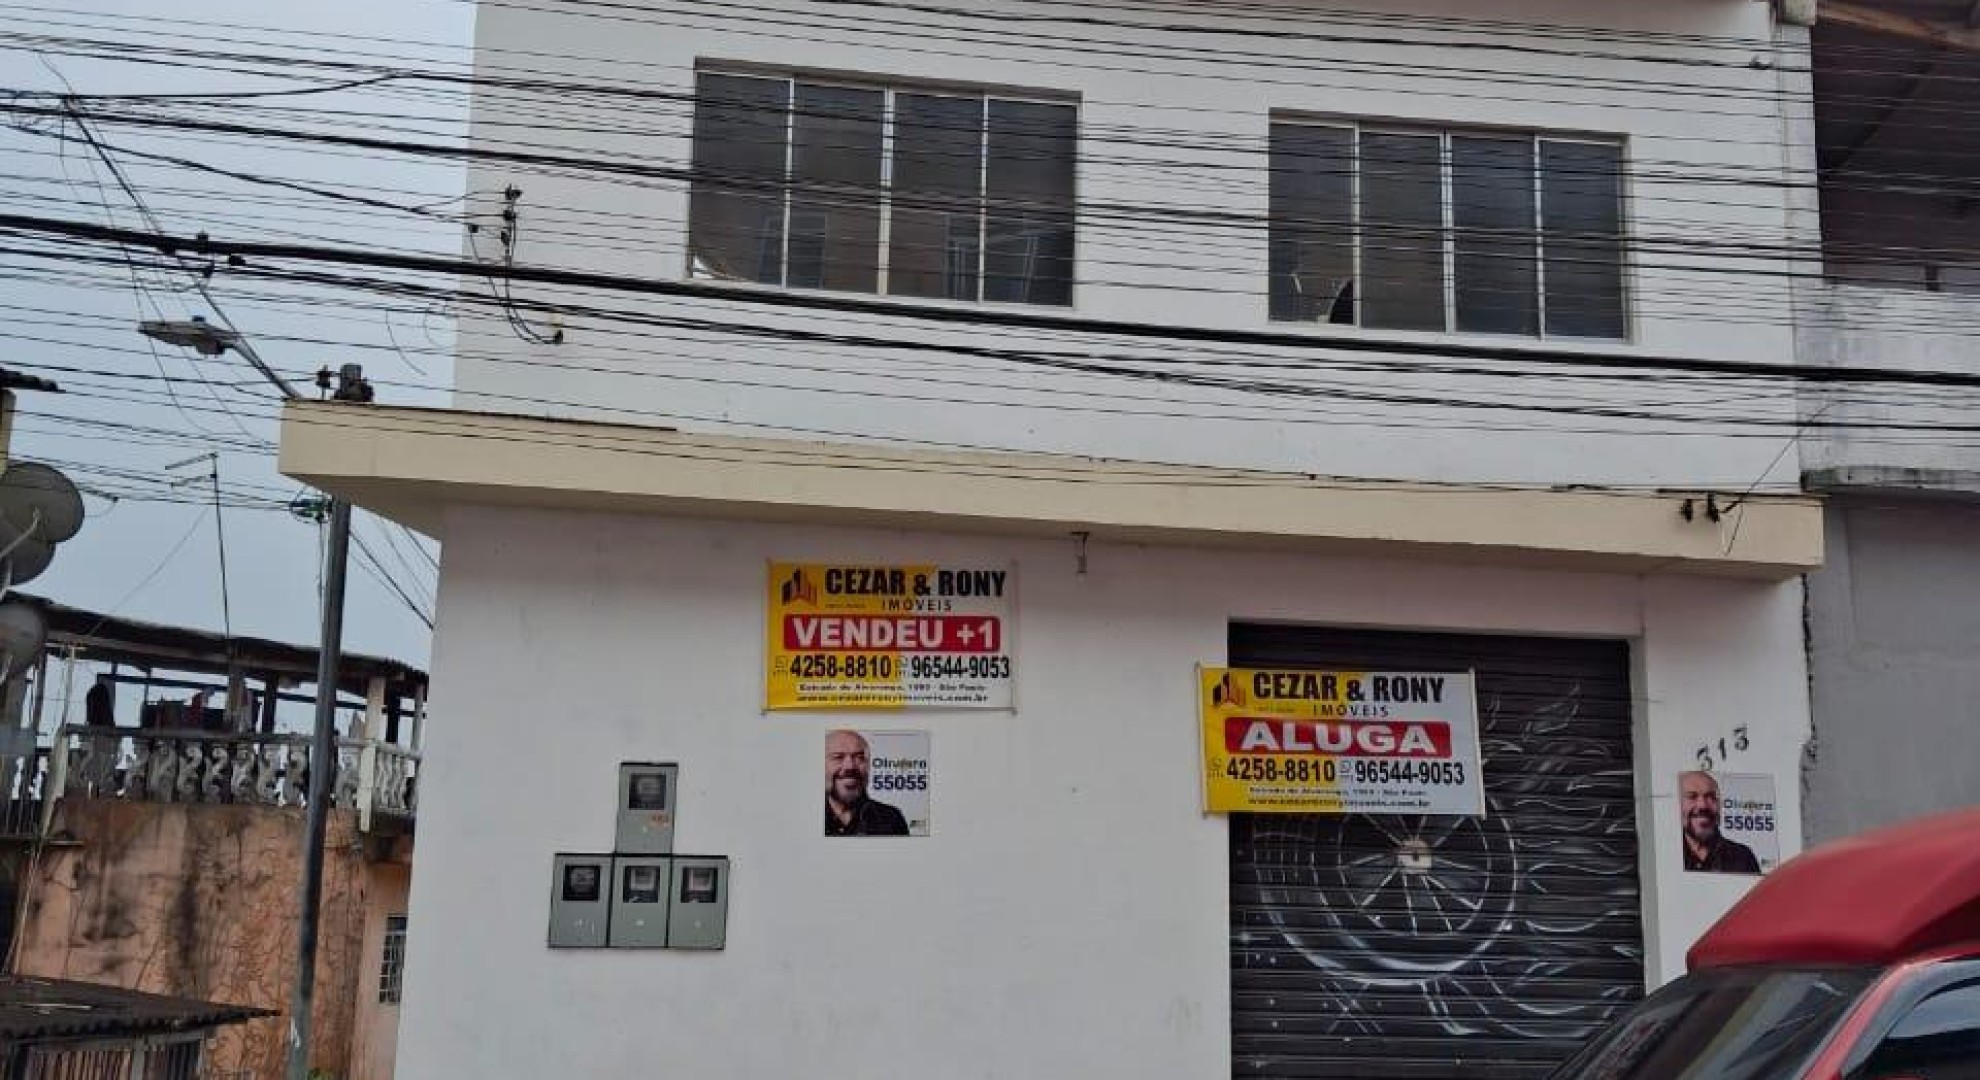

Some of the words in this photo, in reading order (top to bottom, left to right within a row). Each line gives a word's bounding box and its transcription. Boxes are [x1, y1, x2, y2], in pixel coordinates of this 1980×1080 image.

[825, 568, 906, 595] CEZAR
[913, 574, 931, 596] &
[938, 570, 1007, 597] RONY
[792, 617, 944, 648] VENDEU
[956, 618, 994, 648] +1
[790, 655, 891, 679] 4258-8810
[911, 656, 1010, 679] 96544-9053
[1253, 672, 1338, 701] CEZAR
[1346, 679, 1365, 701] &
[1373, 676, 1445, 704] RONY
[1241, 721, 1437, 754] ALUGA
[1697, 726, 1749, 771] 313
[873, 774, 926, 790] 55055
[1227, 757, 1335, 781] 4258-8810
[1355, 760, 1465, 785] 96544-9053
[1724, 815, 1774, 832] 55055
